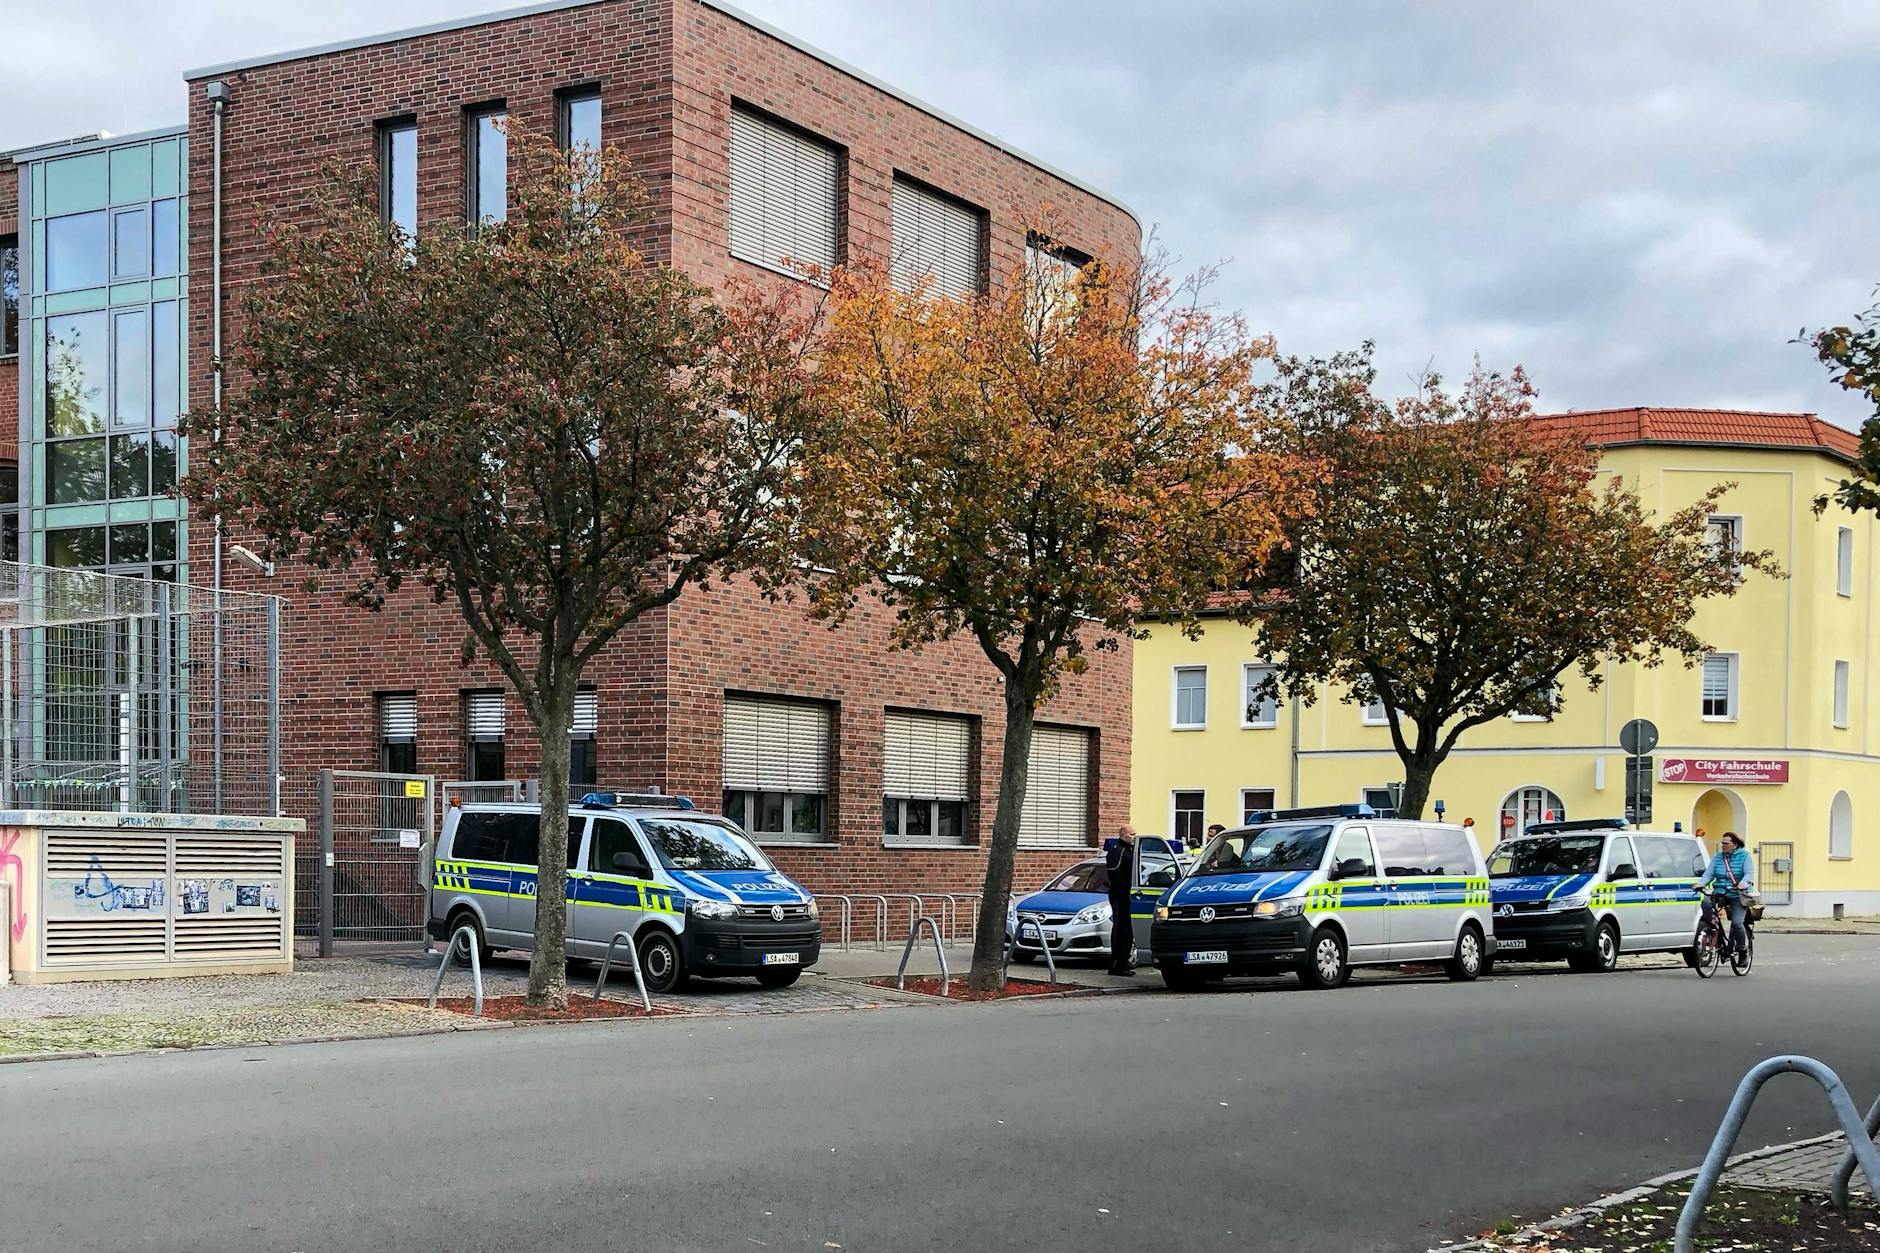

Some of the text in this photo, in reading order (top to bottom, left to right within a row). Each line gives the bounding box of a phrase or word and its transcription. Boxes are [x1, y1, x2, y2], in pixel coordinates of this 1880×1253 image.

[1664, 762, 1685, 778] STOP
[1695, 760, 1782, 773] City Fahrschule
[732, 883, 791, 891] POLIZEI
[1187, 883, 1253, 894] POLIZEI
[1397, 892, 1430, 905] POLIZEI
